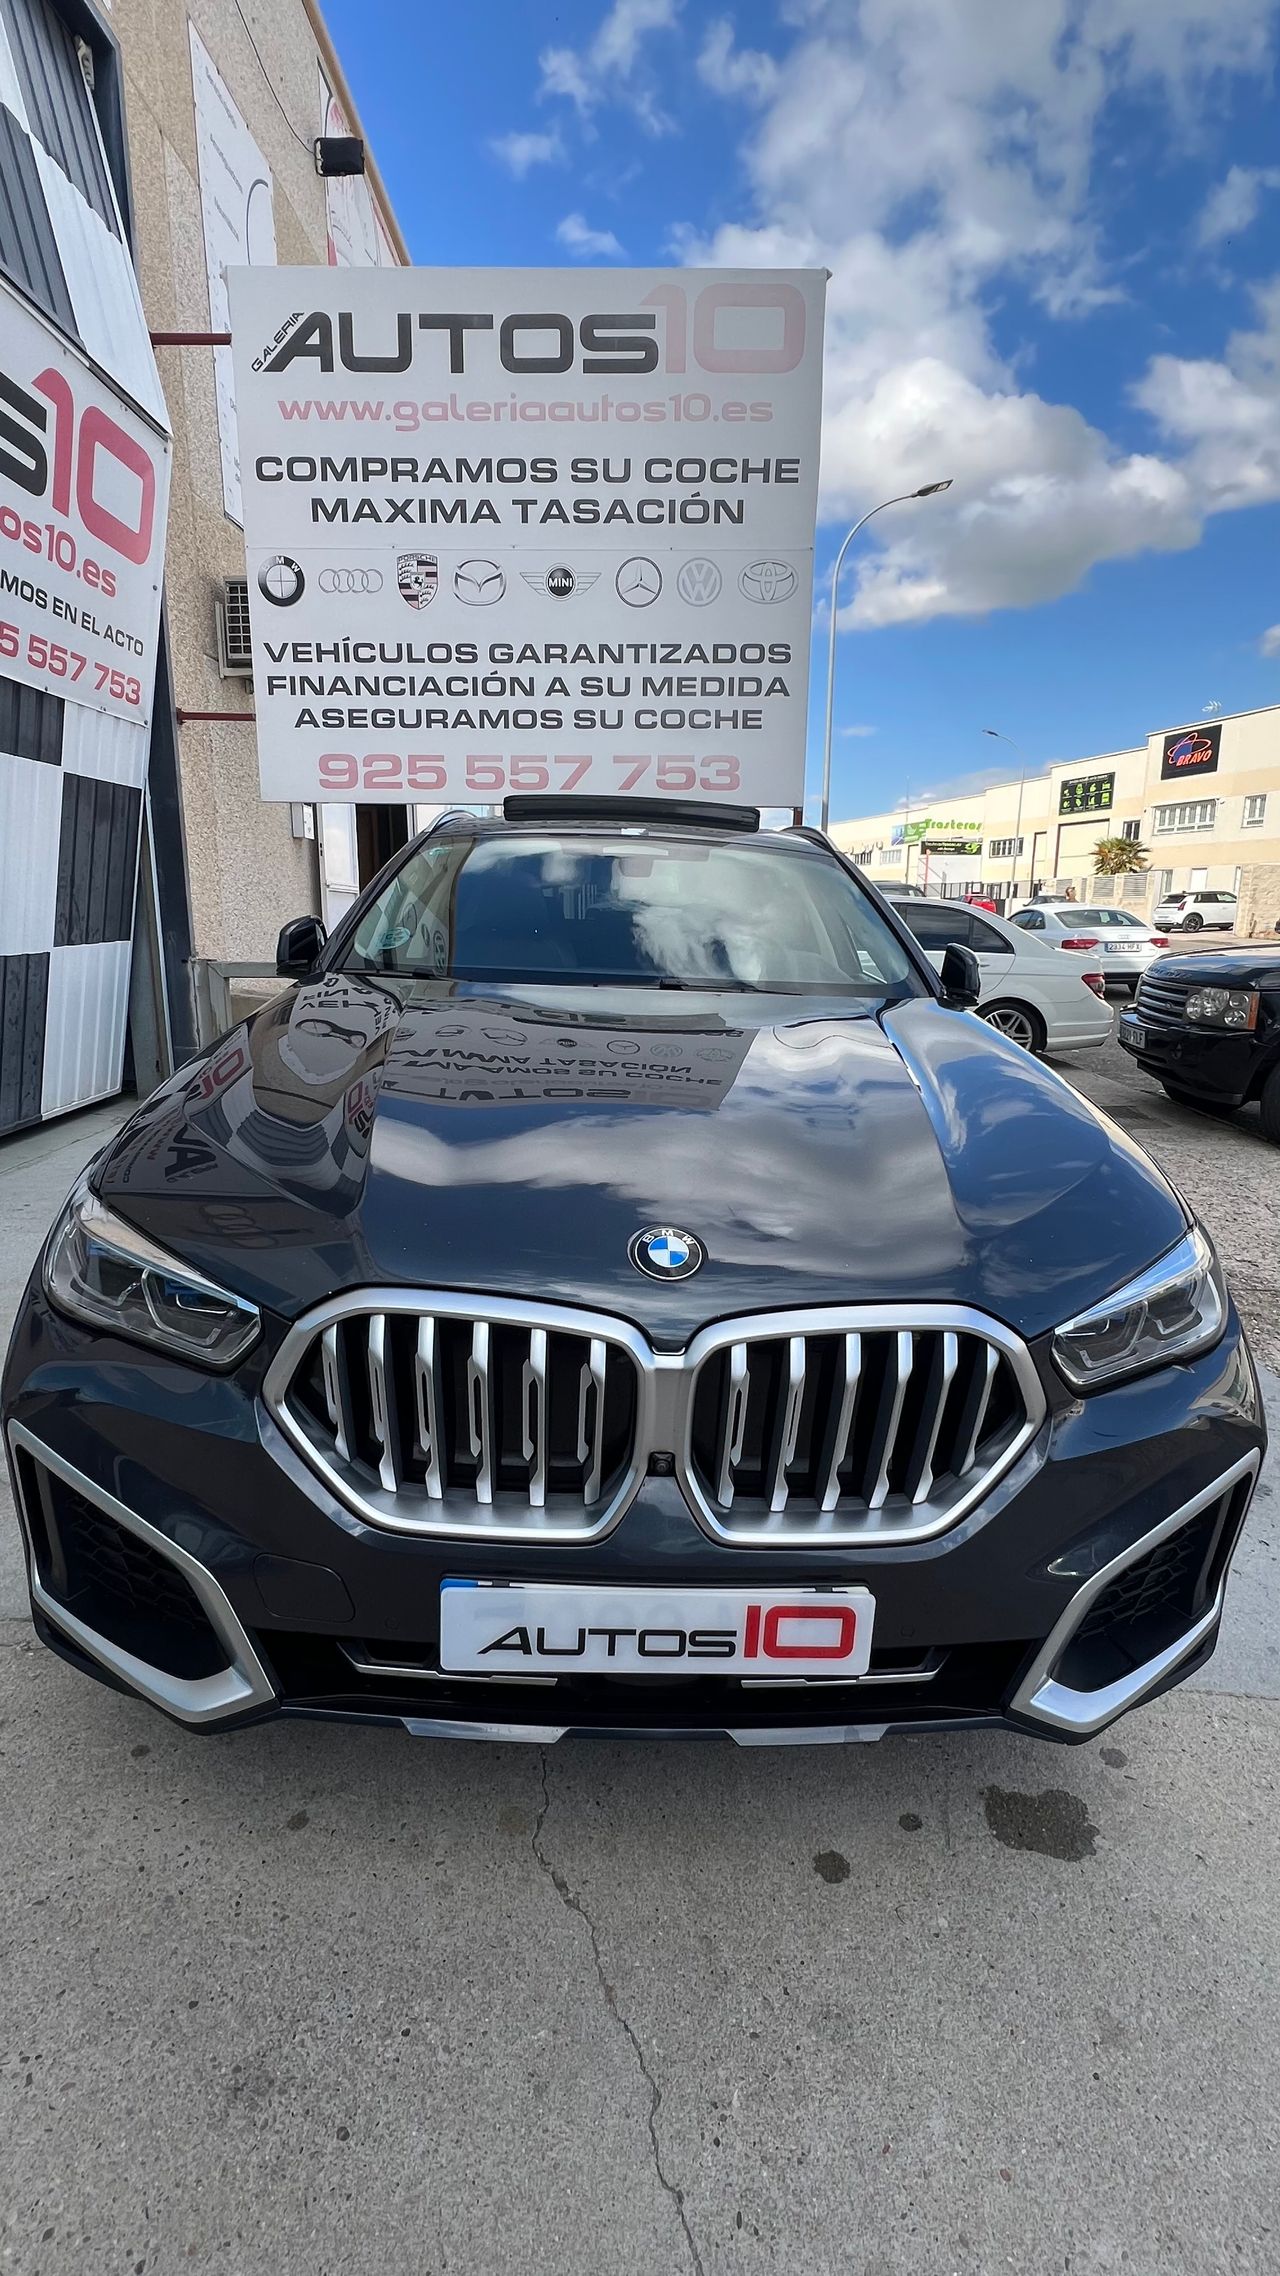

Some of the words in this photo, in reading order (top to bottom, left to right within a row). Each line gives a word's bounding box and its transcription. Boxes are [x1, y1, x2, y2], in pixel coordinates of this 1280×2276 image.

[251, 311, 305, 372] GALERIA
[277, 393, 773, 432] www.galeriaautos10.es
[256, 456, 558, 483] COMPRAMOS
[571, 458, 631, 483] SU
[644, 458, 801, 484] COCHE
[312, 497, 502, 524] MAXIMA
[512, 491, 745, 525] TASACIÓN
[549, 577, 573, 588] MINI
[52, 596, 77, 624] EN
[81, 611, 100, 636] EL
[103, 625, 144, 656] ACTO
[263, 637, 478, 664] VEHÍCULOS
[488, 643, 792, 664] GARANTIZADOS
[27, 634, 87, 681] 557
[94, 662, 141, 705] 753
[267, 670, 536, 697] FINANCIACIÓN
[545, 675, 570, 697] A
[581, 676, 631, 697] SU
[642, 676, 790, 698] MEDIDA
[295, 709, 562, 730] ASEGURAMOS
[573, 709, 623, 730] SU
[635, 709, 762, 730] COCHE
[318, 753, 447, 791] 925
[465, 755, 593, 791] 557
[612, 755, 741, 791] 753
[1176, 750, 1212, 767] BRAVO
[641, 1229, 695, 1245] BMW
[477, 1605, 856, 1660] AUTOS10
